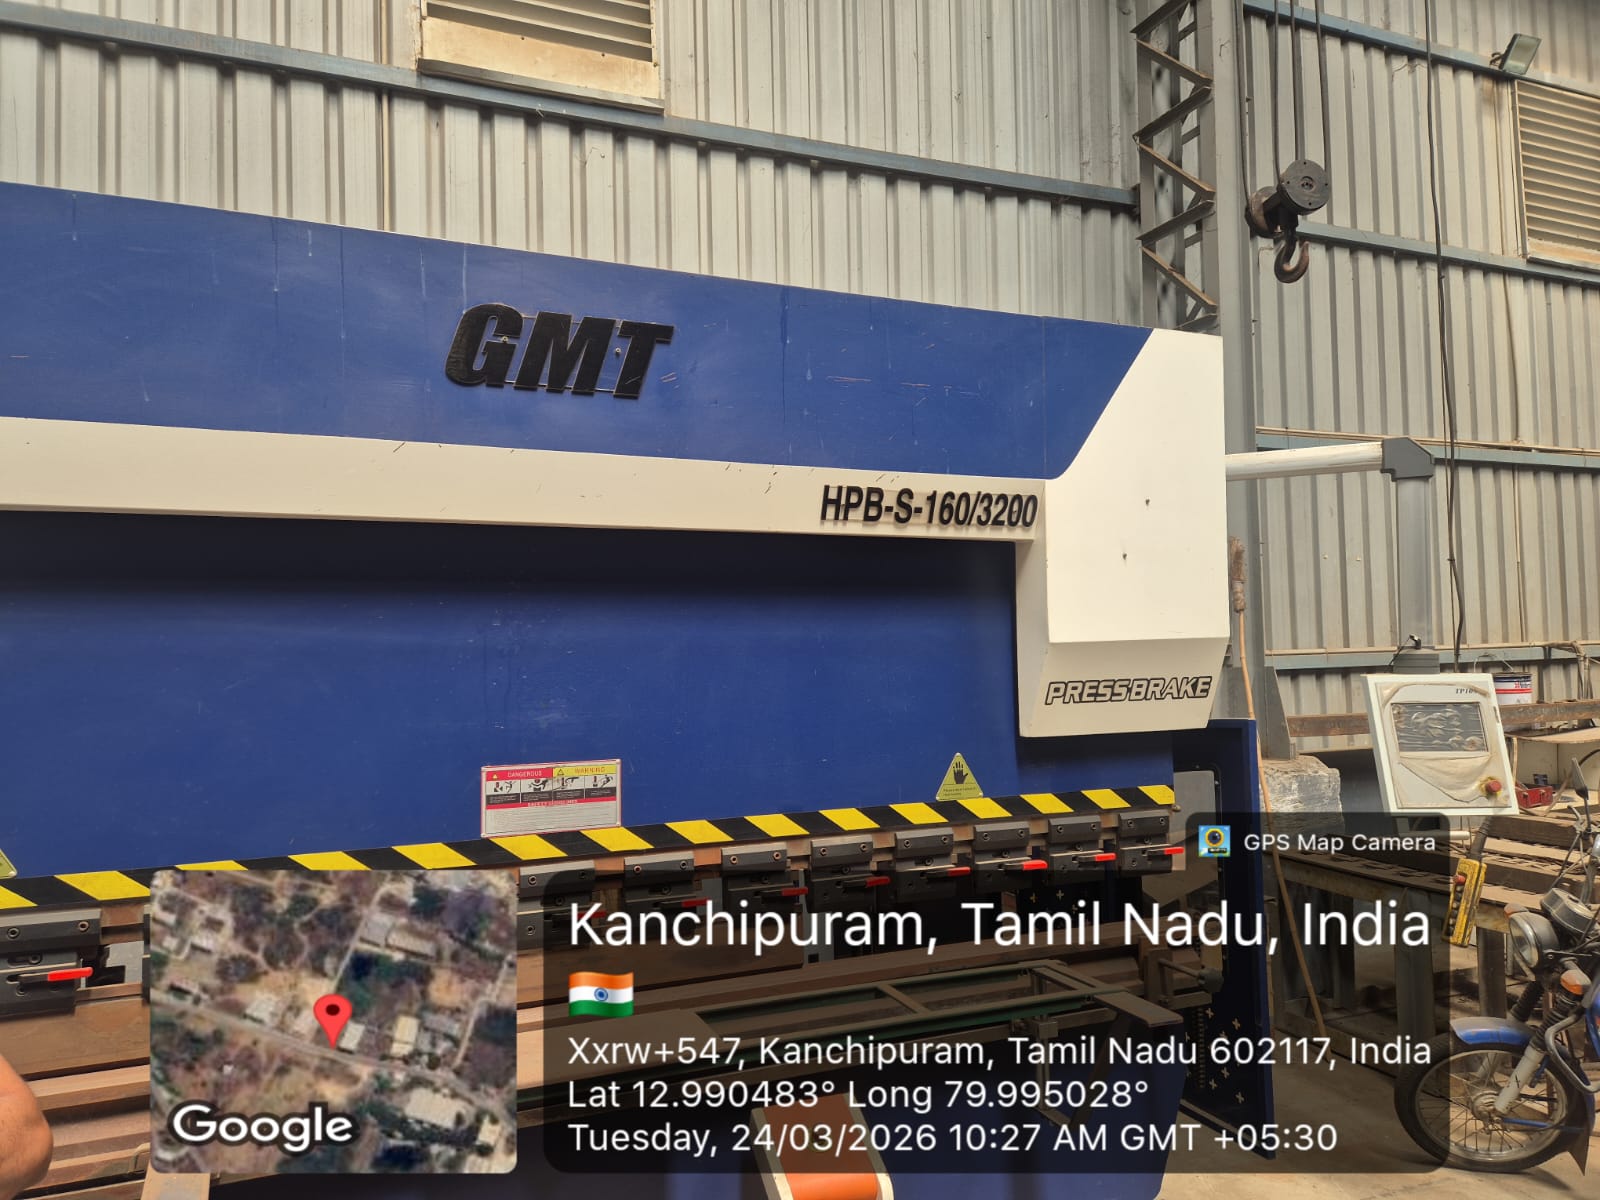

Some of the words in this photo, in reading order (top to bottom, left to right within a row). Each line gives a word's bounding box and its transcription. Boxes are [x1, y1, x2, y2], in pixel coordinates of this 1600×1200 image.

[445, 303, 674, 398] GMT
[821, 485, 1038, 527] HPB-S-160/3200
[1045, 676, 1212, 705] PRESSBRAKE
[507, 770, 542, 778] DANGEROUS
[574, 766, 606, 774] WARNING
